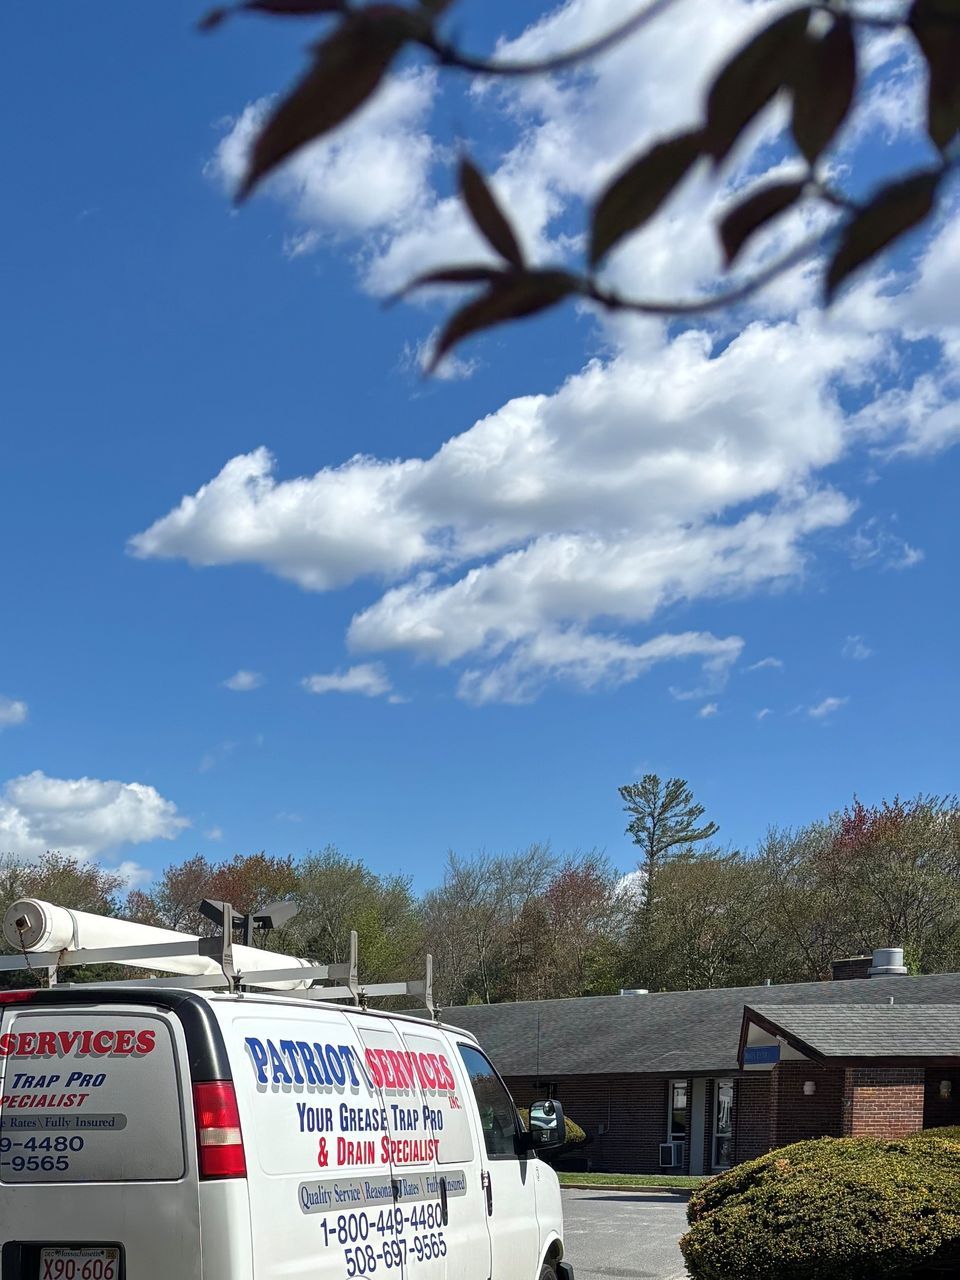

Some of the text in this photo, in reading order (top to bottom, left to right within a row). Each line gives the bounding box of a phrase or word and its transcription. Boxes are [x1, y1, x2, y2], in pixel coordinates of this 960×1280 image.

[244, 1037, 455, 1091] PATRIOT SERVICES
[12, 1073, 60, 1089] TRAP
[65, 1071, 107, 1088] PRO
[10, 1117, 37, 1128] Rates
[45, 1116, 72, 1129] Fully
[76, 1115, 116, 1128] Insured
[296, 1102, 333, 1132] YOUR
[391, 1104, 419, 1131] TRAP
[422, 1105, 444, 1131] PRO
[317, 1135, 440, 1168] & DRAIN SPECIALIST
[301, 1185, 332, 1210] Quality
[334, 1183, 361, 1203] Service
[320, 1202, 442, 1247] 1-800-449-4480
[344, 1232, 447, 1277] 508-697-9565
